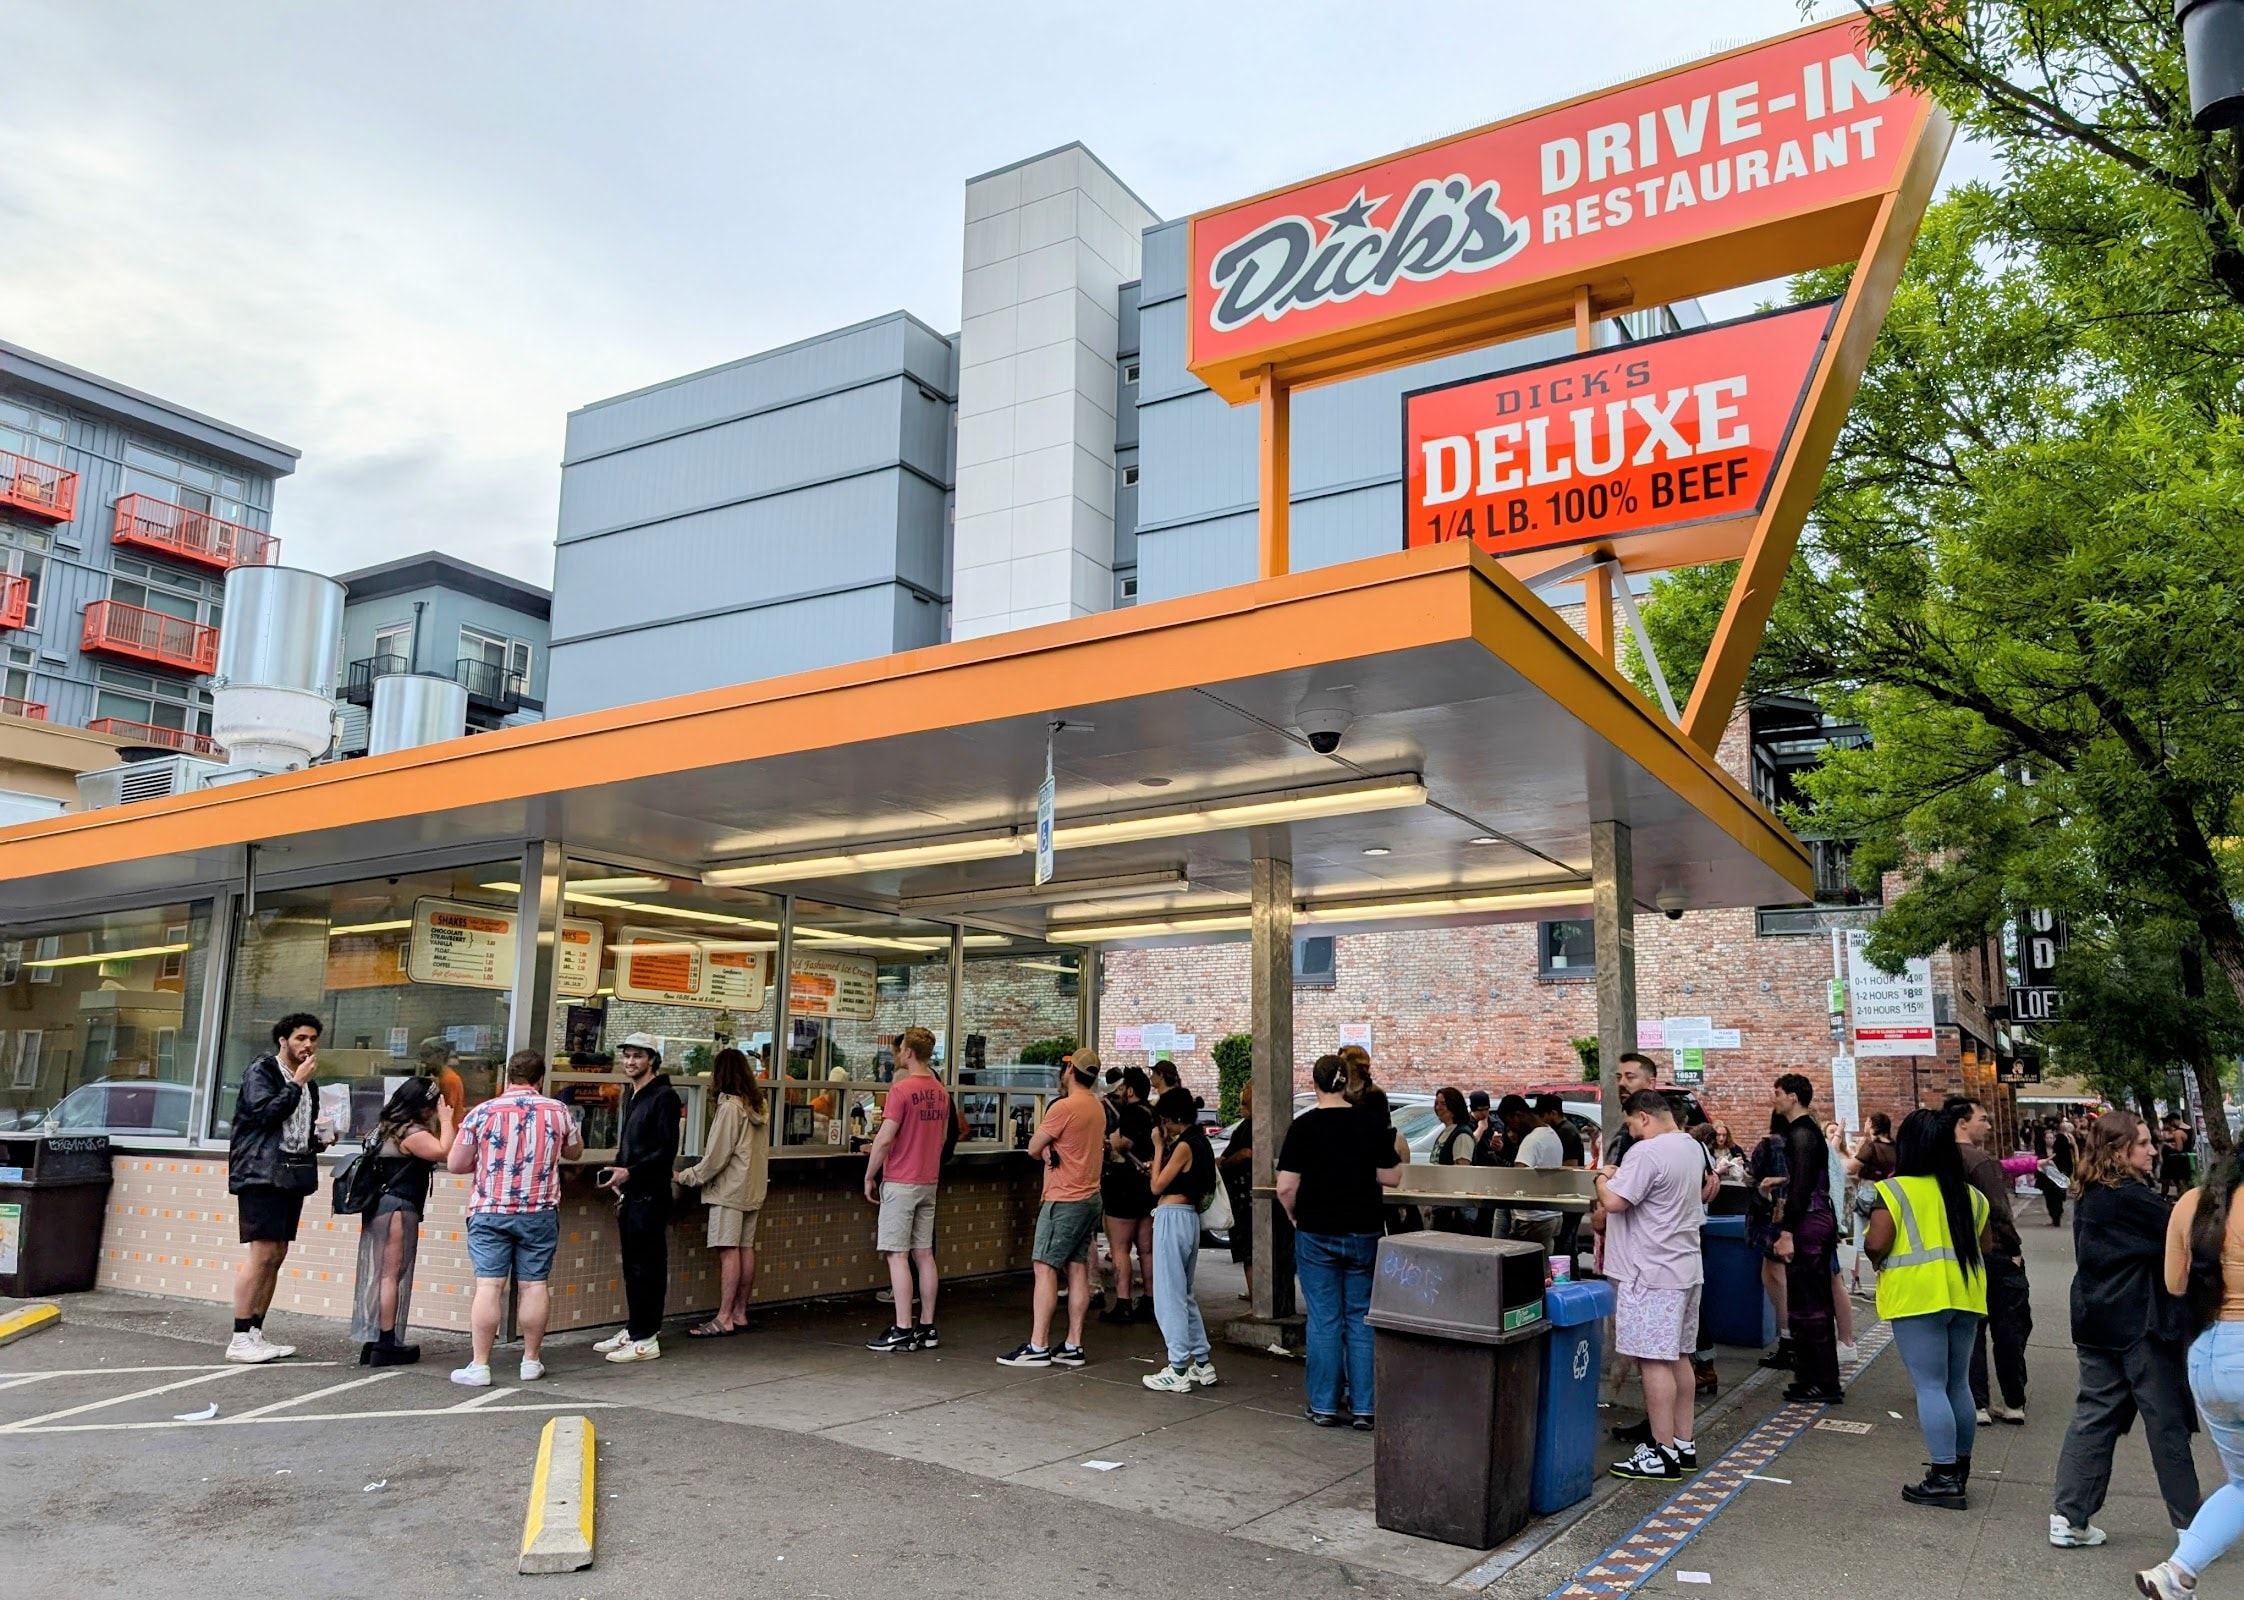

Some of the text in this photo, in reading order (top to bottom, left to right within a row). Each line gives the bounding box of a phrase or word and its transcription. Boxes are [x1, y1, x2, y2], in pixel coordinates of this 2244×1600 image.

[1540, 48, 1891, 197] DRIVE-IN
[1543, 115, 1884, 246] RESTAURANT
[1212, 176, 1524, 329] Dick's
[1496, 360, 1650, 416] DICK'S
[1422, 375, 1750, 506] DELUXE
[1427, 457, 1749, 544] 1/4 LB. 100% BEEF
[438, 914, 467, 928] SHAKES
[430, 927, 464, 936] CHOCOLATE
[430, 933, 467, 943] STRAWBERRY
[429, 939, 453, 947] VANILLA
[803, 960, 841, 972] Fashioned
[841, 963, 852, 974] Ice
[852, 966, 873, 979] Cream
[1855, 977, 1867, 986] 0-1
[1870, 975, 1896, 985] HOUR
[1855, 991, 1868, 1000] 1-2
[1869, 991, 1900, 1000] HOURS
[1857, 1006, 1872, 1015] 2-10
[1873, 1005, 1901, 1014] HOURS
[911, 1088, 936, 1106] BAKE
